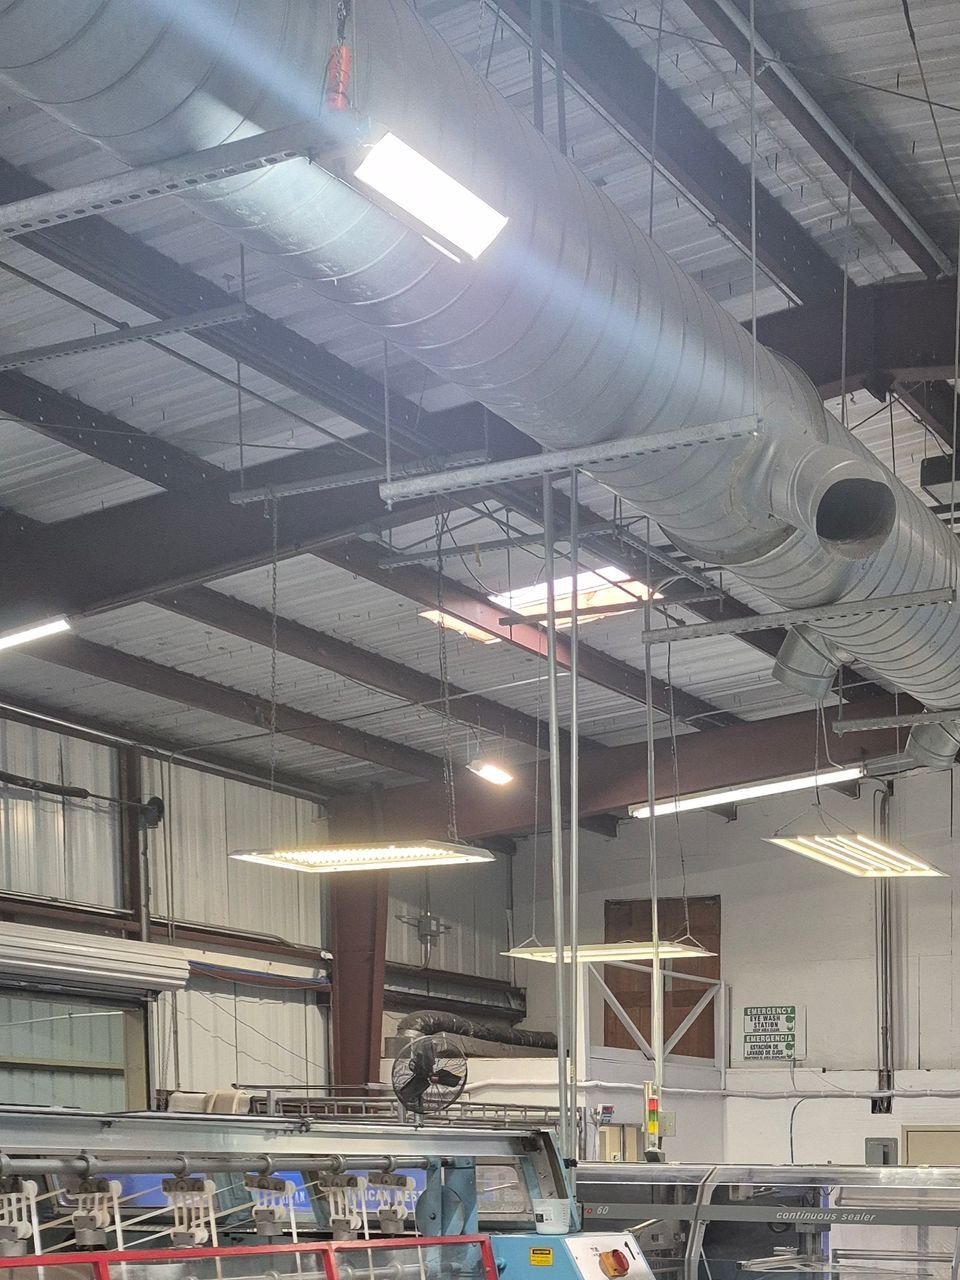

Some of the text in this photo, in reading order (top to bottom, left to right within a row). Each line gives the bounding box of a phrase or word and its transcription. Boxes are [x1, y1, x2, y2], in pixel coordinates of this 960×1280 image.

[596, 1206, 609, 1215] 60
[776, 1210, 877, 1222] continuous sealer
